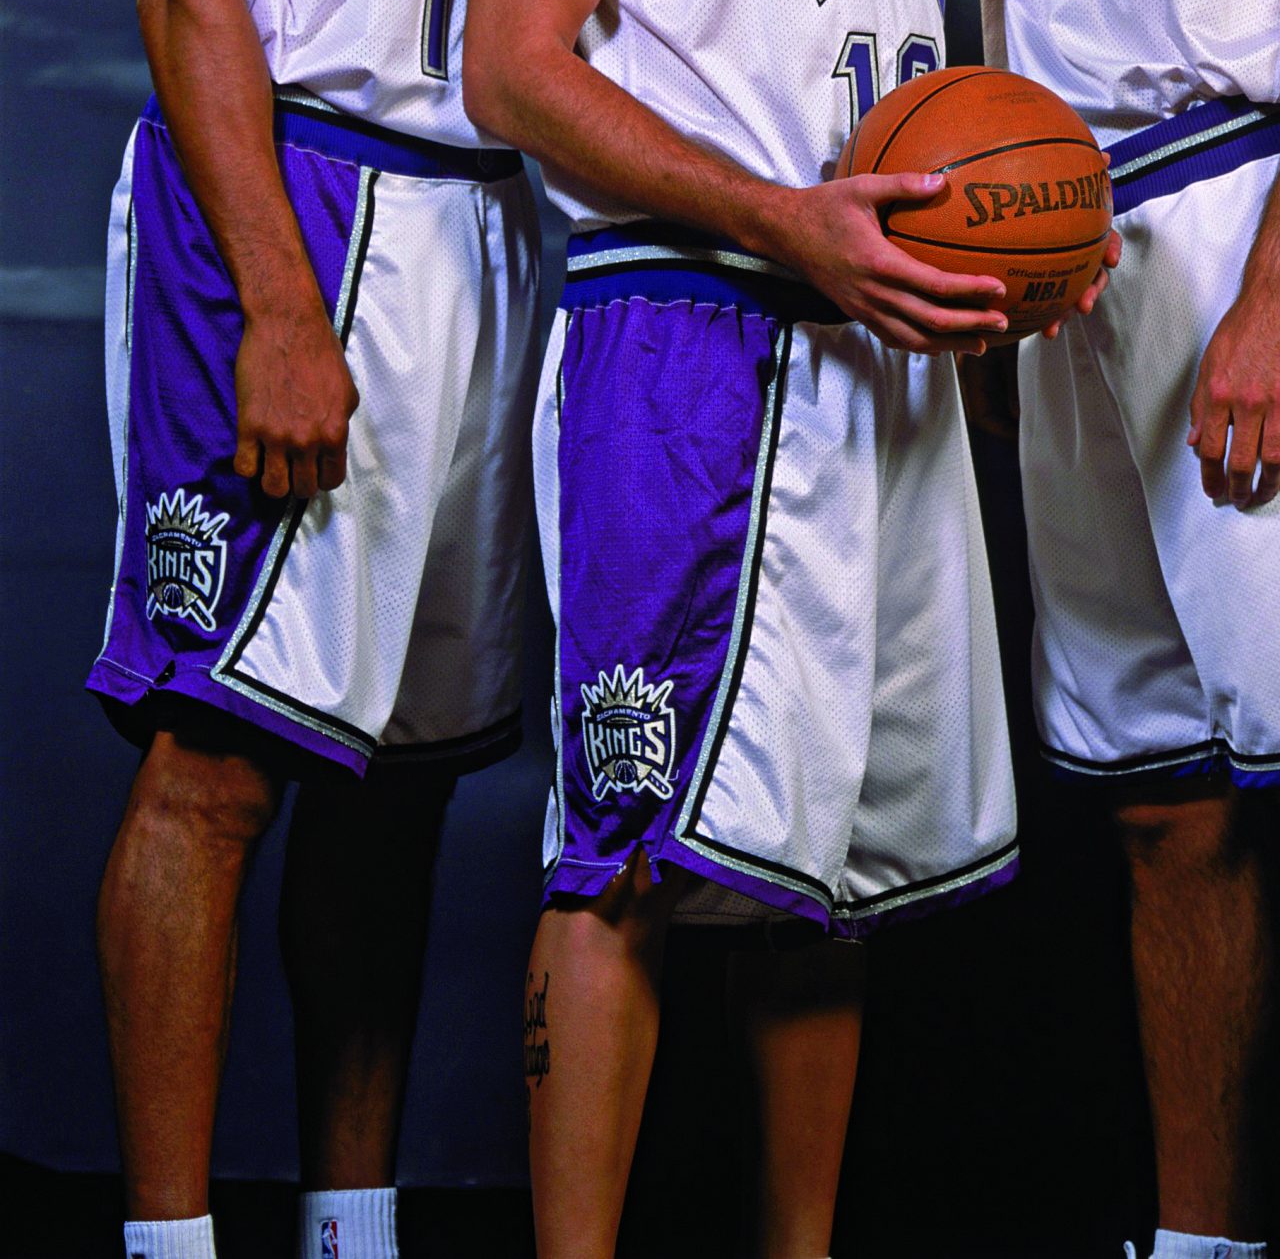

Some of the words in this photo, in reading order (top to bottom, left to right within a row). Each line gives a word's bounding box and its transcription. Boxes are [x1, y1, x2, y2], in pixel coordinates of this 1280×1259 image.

[964, 169, 1111, 228] SPALDING
[1007, 268, 1045, 279] Official
[1023, 278, 1069, 302] NBA
[148, 544, 215, 598] KINGS
[596, 707, 651, 722] SACRAMENTO
[588, 720, 666, 768] KINGS
